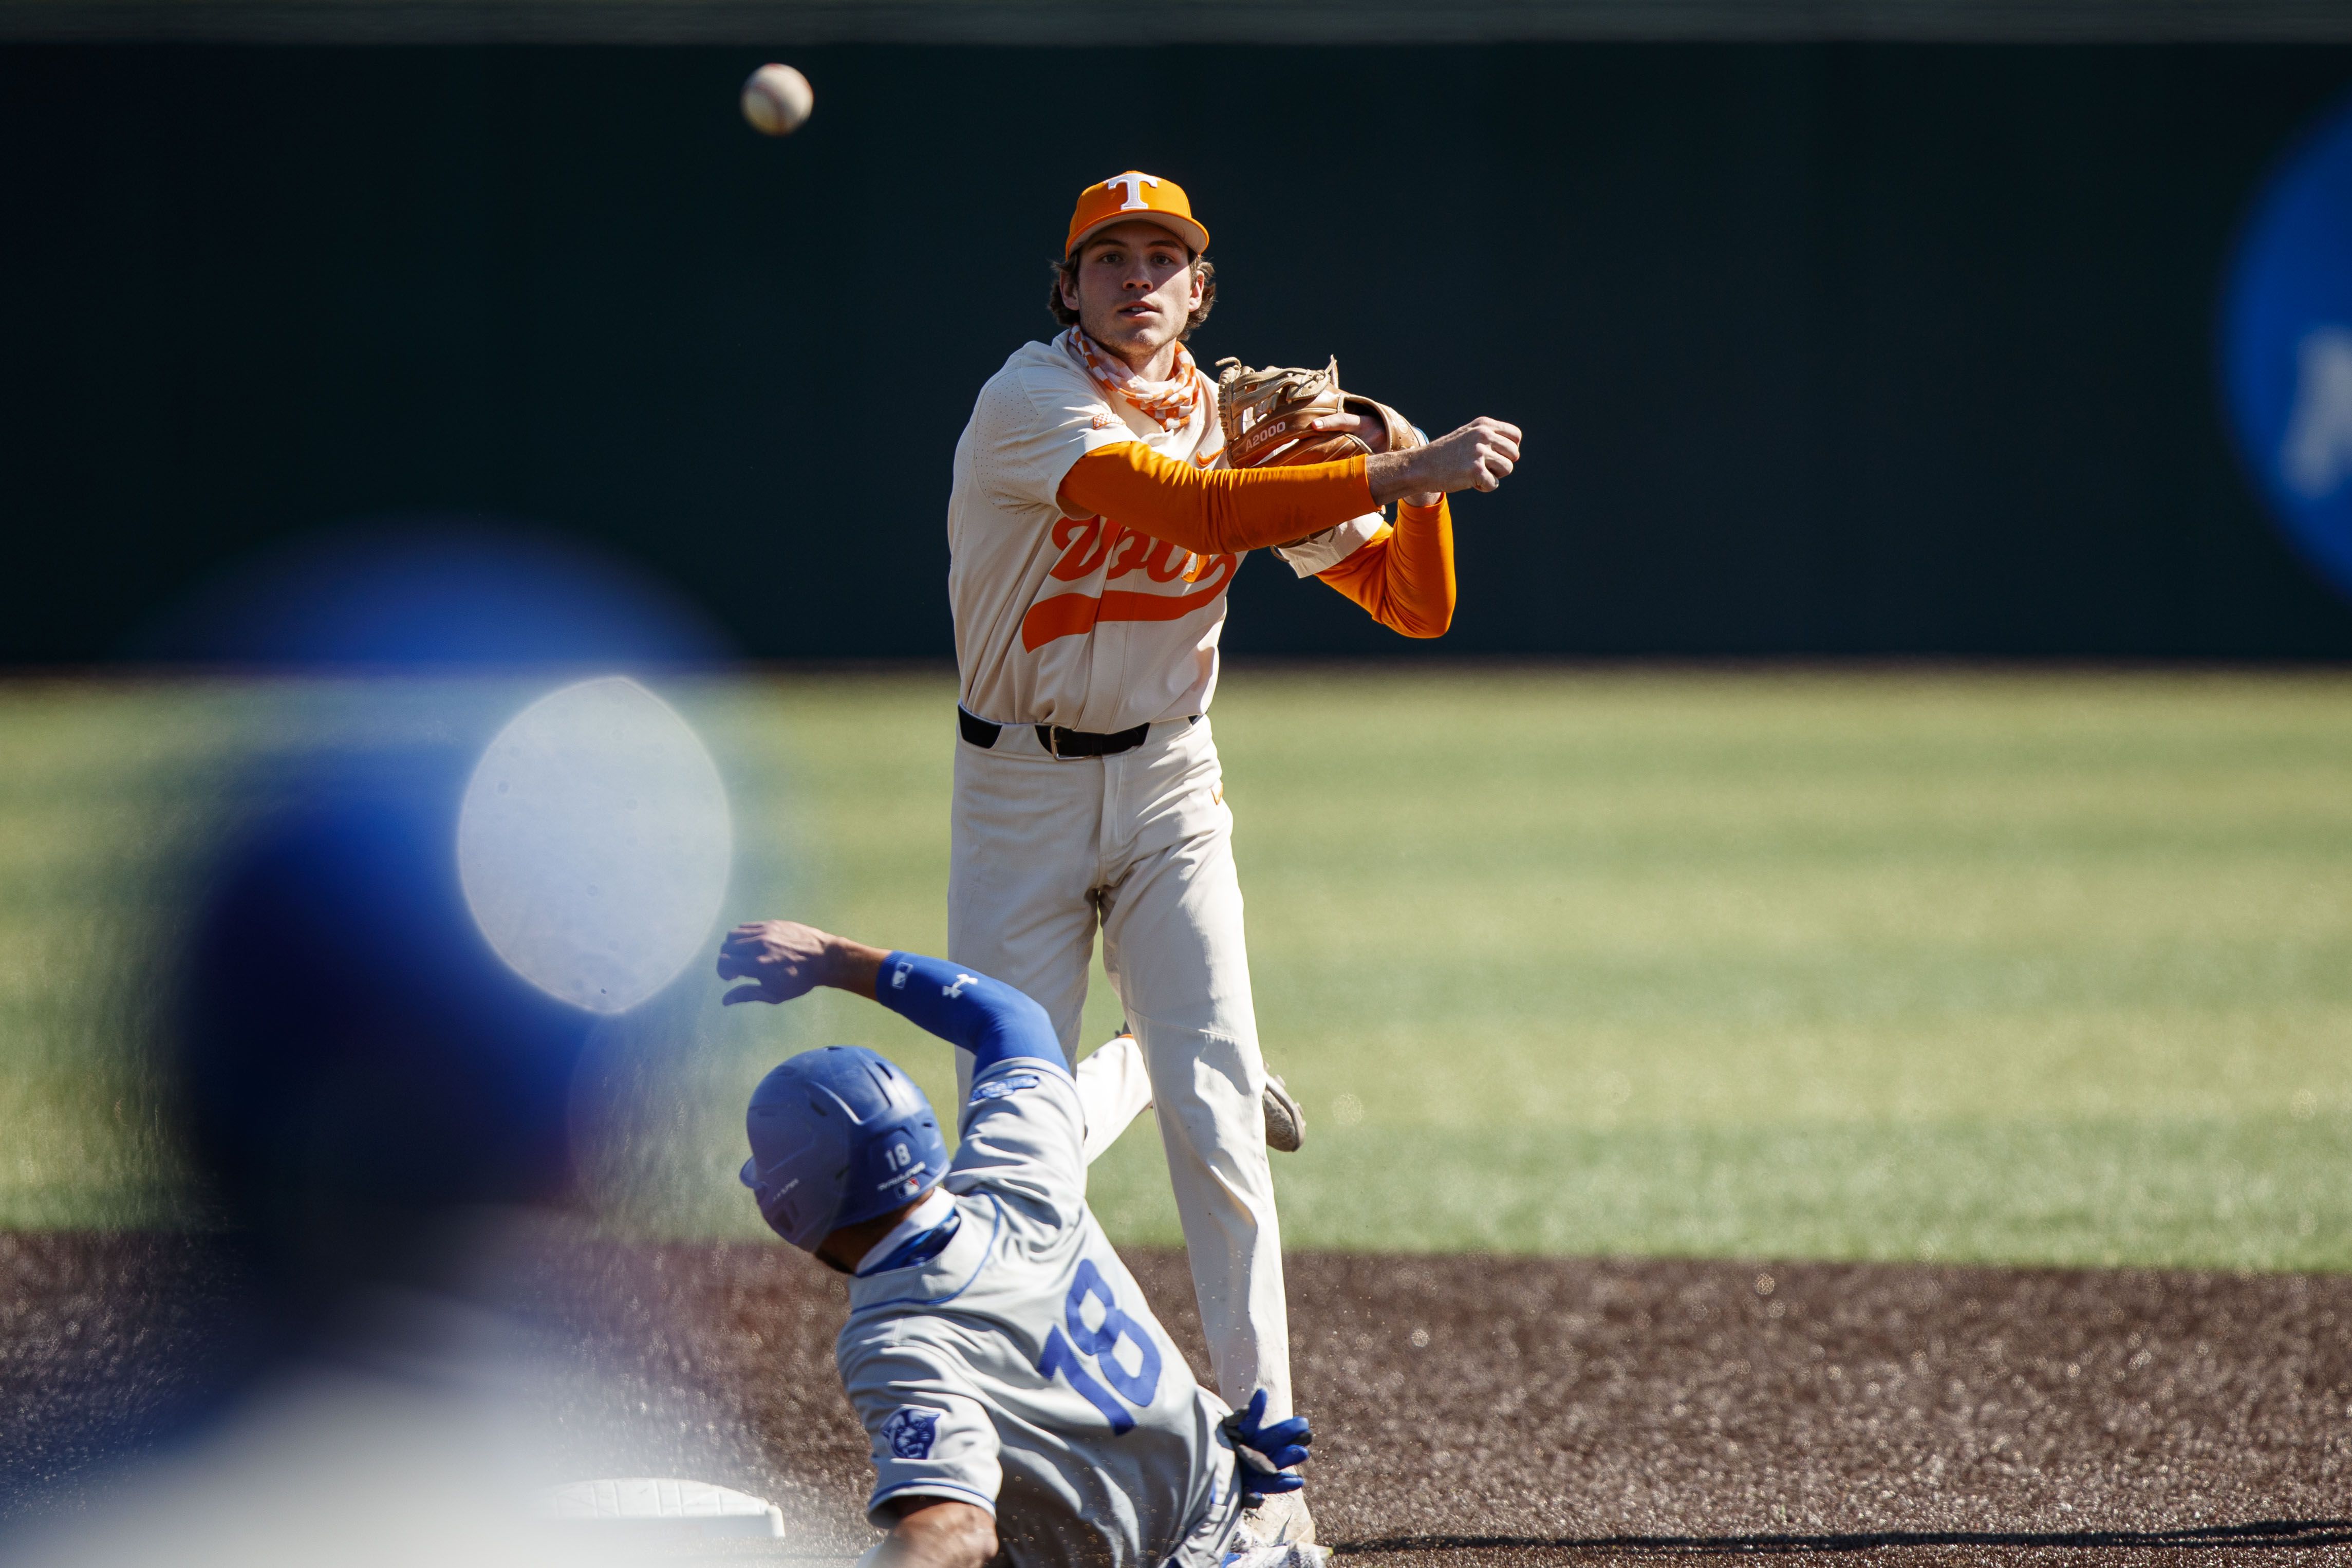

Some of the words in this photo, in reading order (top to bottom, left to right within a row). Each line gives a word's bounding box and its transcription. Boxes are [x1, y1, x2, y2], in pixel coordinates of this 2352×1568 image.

[1103, 173, 1161, 210] T
[1246, 421, 1285, 452] A2000
[885, 1142, 911, 1171] 18
[1037, 1259, 1162, 1436] 18
